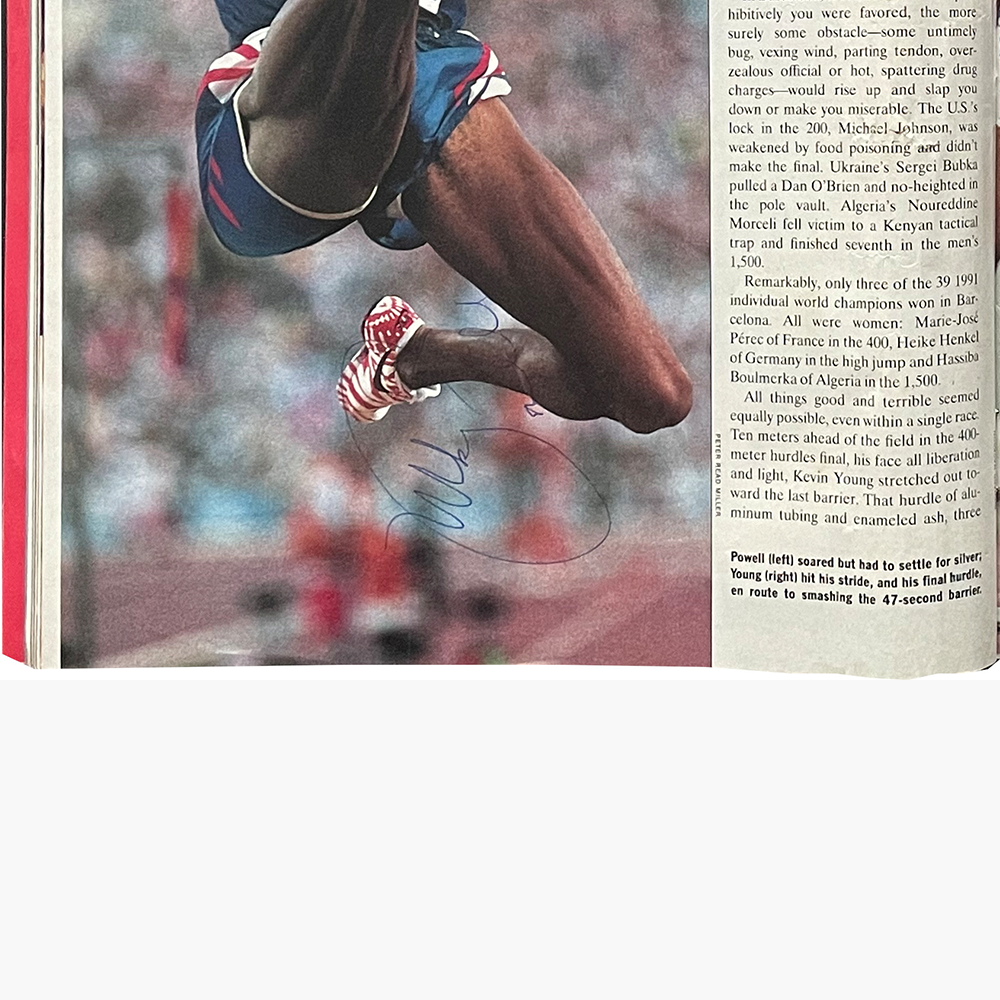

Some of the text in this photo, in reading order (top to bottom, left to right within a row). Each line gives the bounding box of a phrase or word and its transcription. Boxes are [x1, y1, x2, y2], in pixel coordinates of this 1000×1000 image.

[835, 83, 856, 95] rise
[866, 87, 881, 98] up
[891, 84, 916, 96] and
[925, 84, 950, 98] slap
[958, 86, 977, 96] you
[729, 160, 762, 172] make
[768, 160, 787, 172] the
[794, 160, 823, 173] final.
[896, 160, 937, 175] Sergei
[942, 159, 978, 172] Bubka
[730, 238, 754, 252] trap
[761, 237, 783, 249] and
[791, 237, 838, 250] finished
[845, 239, 892, 251] seventh
[901, 239, 913, 251] in
[921, 238, 940, 250] the
[731, 330, 979, 351] Pérec of France in the 400, Heike Henkel
[744, 390, 979, 408] All things good and terrible seemed
[731, 505, 981, 526] minum tubing and enameled ash, three
[731, 551, 982, 571] Powell (left) soared but had to settle for silver;
[731, 568, 982, 589] Young (right) hit his stride, and his final hurdle,
[731, 585, 982, 605] en route to smashing the 47-second barrier.
